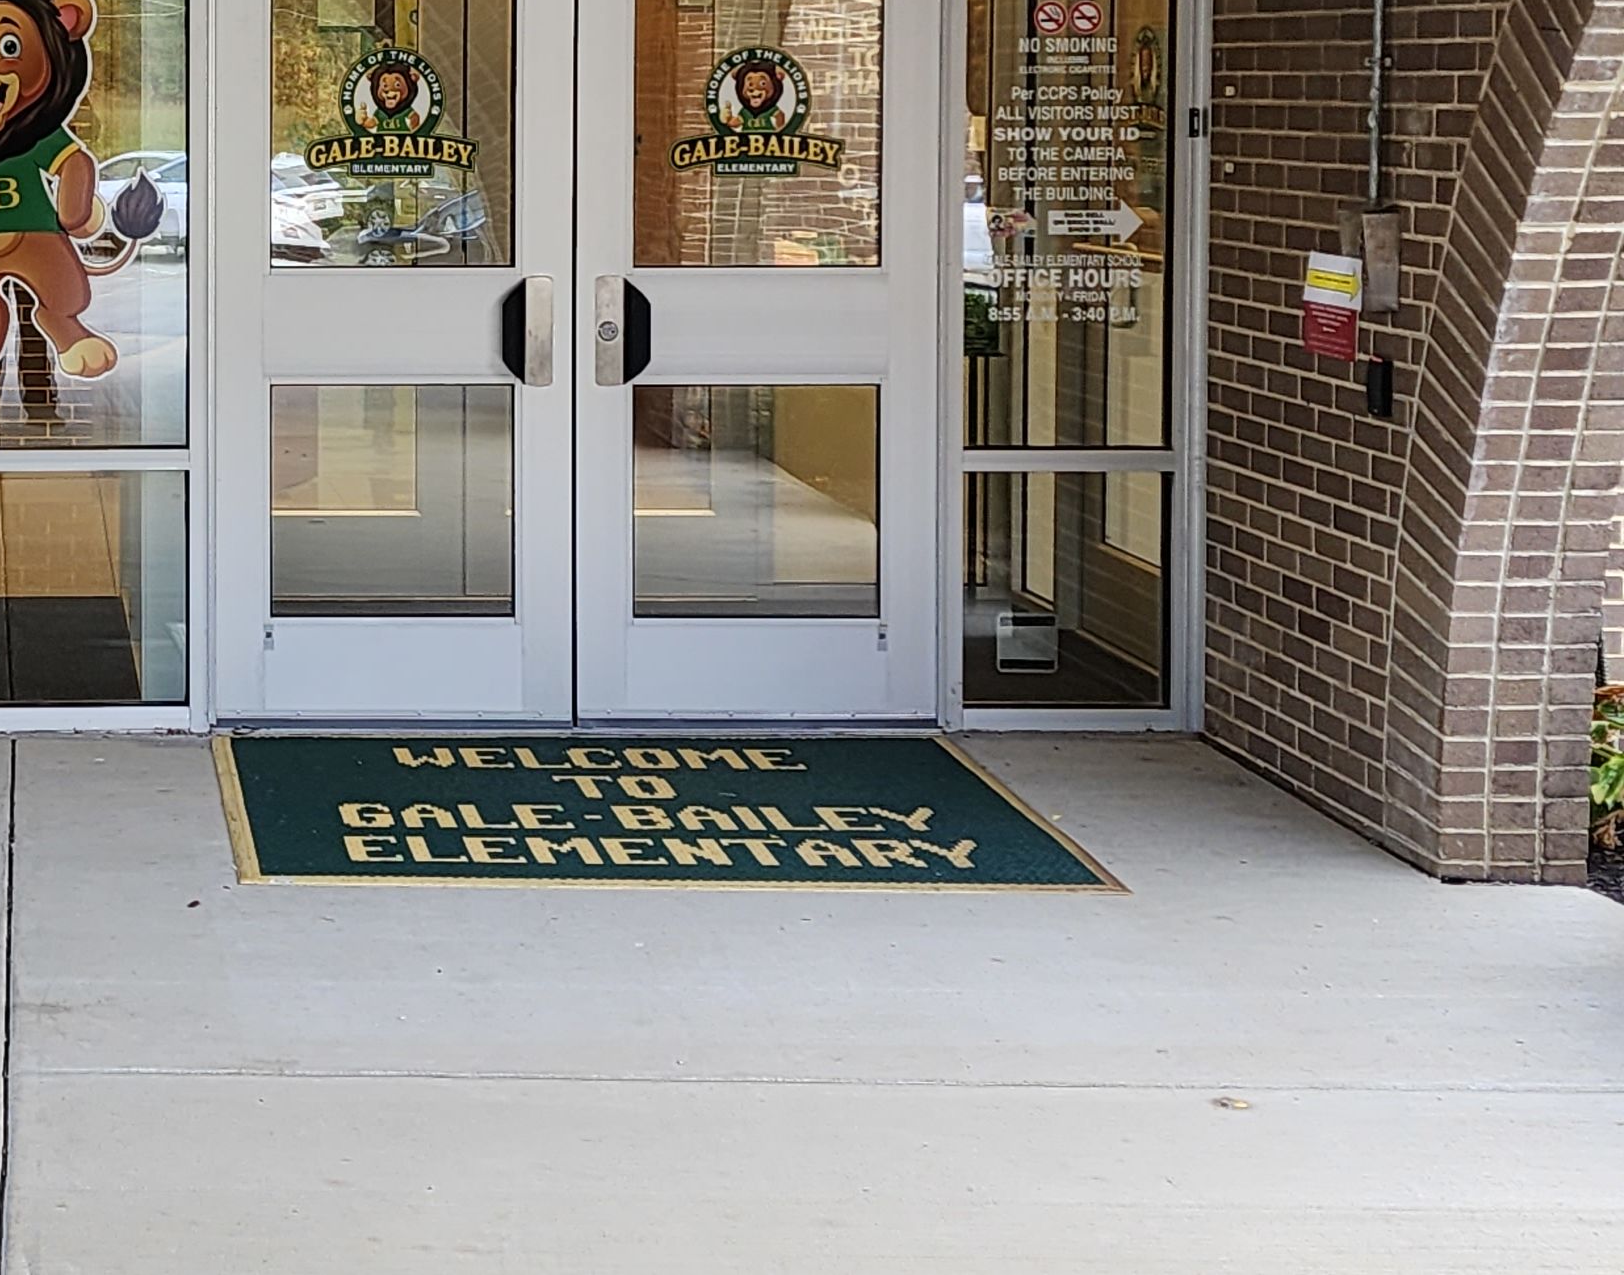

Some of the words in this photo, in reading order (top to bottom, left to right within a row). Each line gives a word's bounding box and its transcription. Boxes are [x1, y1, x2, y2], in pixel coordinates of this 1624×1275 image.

[1019, 38, 1040, 52] NO
[1045, 38, 1117, 53] SMOKING
[343, 64, 367, 99] HOME
[367, 50, 385, 64] OF
[390, 50, 416, 64] THE
[419, 62, 442, 100] LIONS
[707, 63, 730, 99] HOME
[731, 49, 750, 63] OF
[755, 49, 782, 63] THE
[782, 60, 810, 99] LIONS
[1011, 86, 1034, 100] Per
[1038, 86, 1078, 100] CCPS
[1081, 86, 1123, 104] Policy
[996, 106, 1024, 120] ALL
[1028, 106, 1094, 120] VISITORS
[1098, 106, 1139, 120] MUST
[994, 127, 1052, 141] SHOW
[1059, 127, 1113, 141] YOUR
[1119, 127, 1139, 141] ID
[309, 135, 473, 167] GALE-BAILEY
[673, 134, 842, 166] GALE-BAILEY
[1007, 147, 1027, 161] TO
[1031, 147, 1059, 161] THE
[1063, 147, 1126, 161] CAMERA
[352, 164, 430, 174] ELEMENTARY
[717, 163, 795, 173] ELEMENTARY
[998, 167, 1057, 181] BEFORE
[1061, 167, 1134, 181] ENTERING
[1013, 187, 1042, 200] THE
[1046, 187, 1118, 201] BUILDING.
[1047, 254, 1105, 266] ELEMENTARY
[1107, 255, 1143, 266] SCHOOL
[989, 269, 1062, 287] OFFICE
[1069, 269, 1143, 287] HOURS
[1073, 291, 1112, 302] FRIDAY
[988, 308, 1021, 321] 8:55
[1072, 308, 1105, 321] 3:40
[393, 746, 807, 772] WELCOME
[551, 773, 678, 801] TO
[339, 802, 937, 833] GALE-BAILEY
[345, 834, 978, 869] ELEMENTARY
